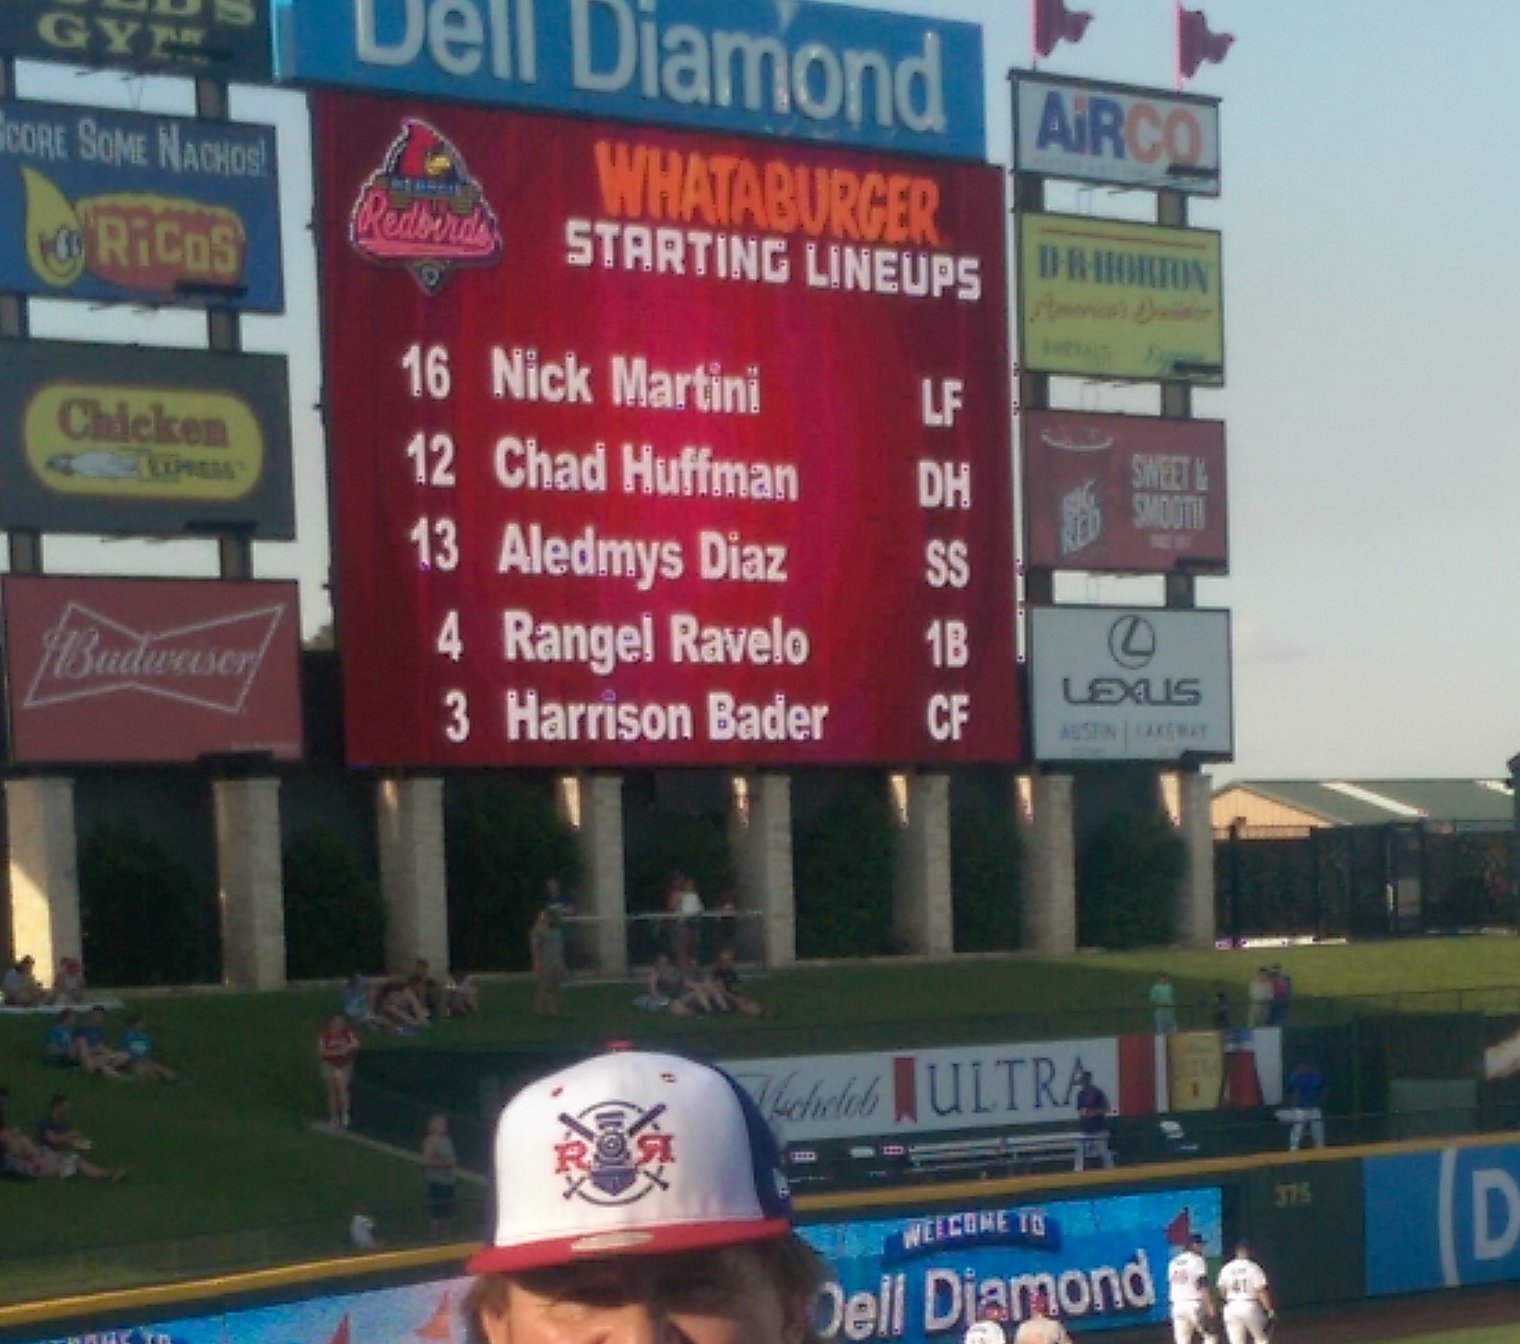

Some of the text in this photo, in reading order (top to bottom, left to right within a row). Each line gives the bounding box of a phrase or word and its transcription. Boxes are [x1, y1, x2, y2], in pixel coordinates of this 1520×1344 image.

[356, 0, 945, 132] Dell Diamond
[595, 140, 941, 245] WHATABURGER
[564, 219, 982, 301] STARTING LINEUPS
[401, 344, 963, 427] 16 Nick Martini LF
[58, 398, 229, 447] Chicken
[406, 432, 971, 510] 12 Chad Huffman DH
[410, 516, 970, 590] 13 Aledmys Diaz SS
[43, 628, 261, 679] Budweiser
[437, 608, 969, 676] 4 Rangel Ravelo 1B
[445, 688, 971, 743] 3 Harrison Bader CF
[1063, 677, 1202, 706] LEXUS
[928, 1055, 1088, 1116] ULTRA
[902, 1210, 1046, 1250] WELCOME TO
[812, 1249, 1154, 1342] Dell Diamond
